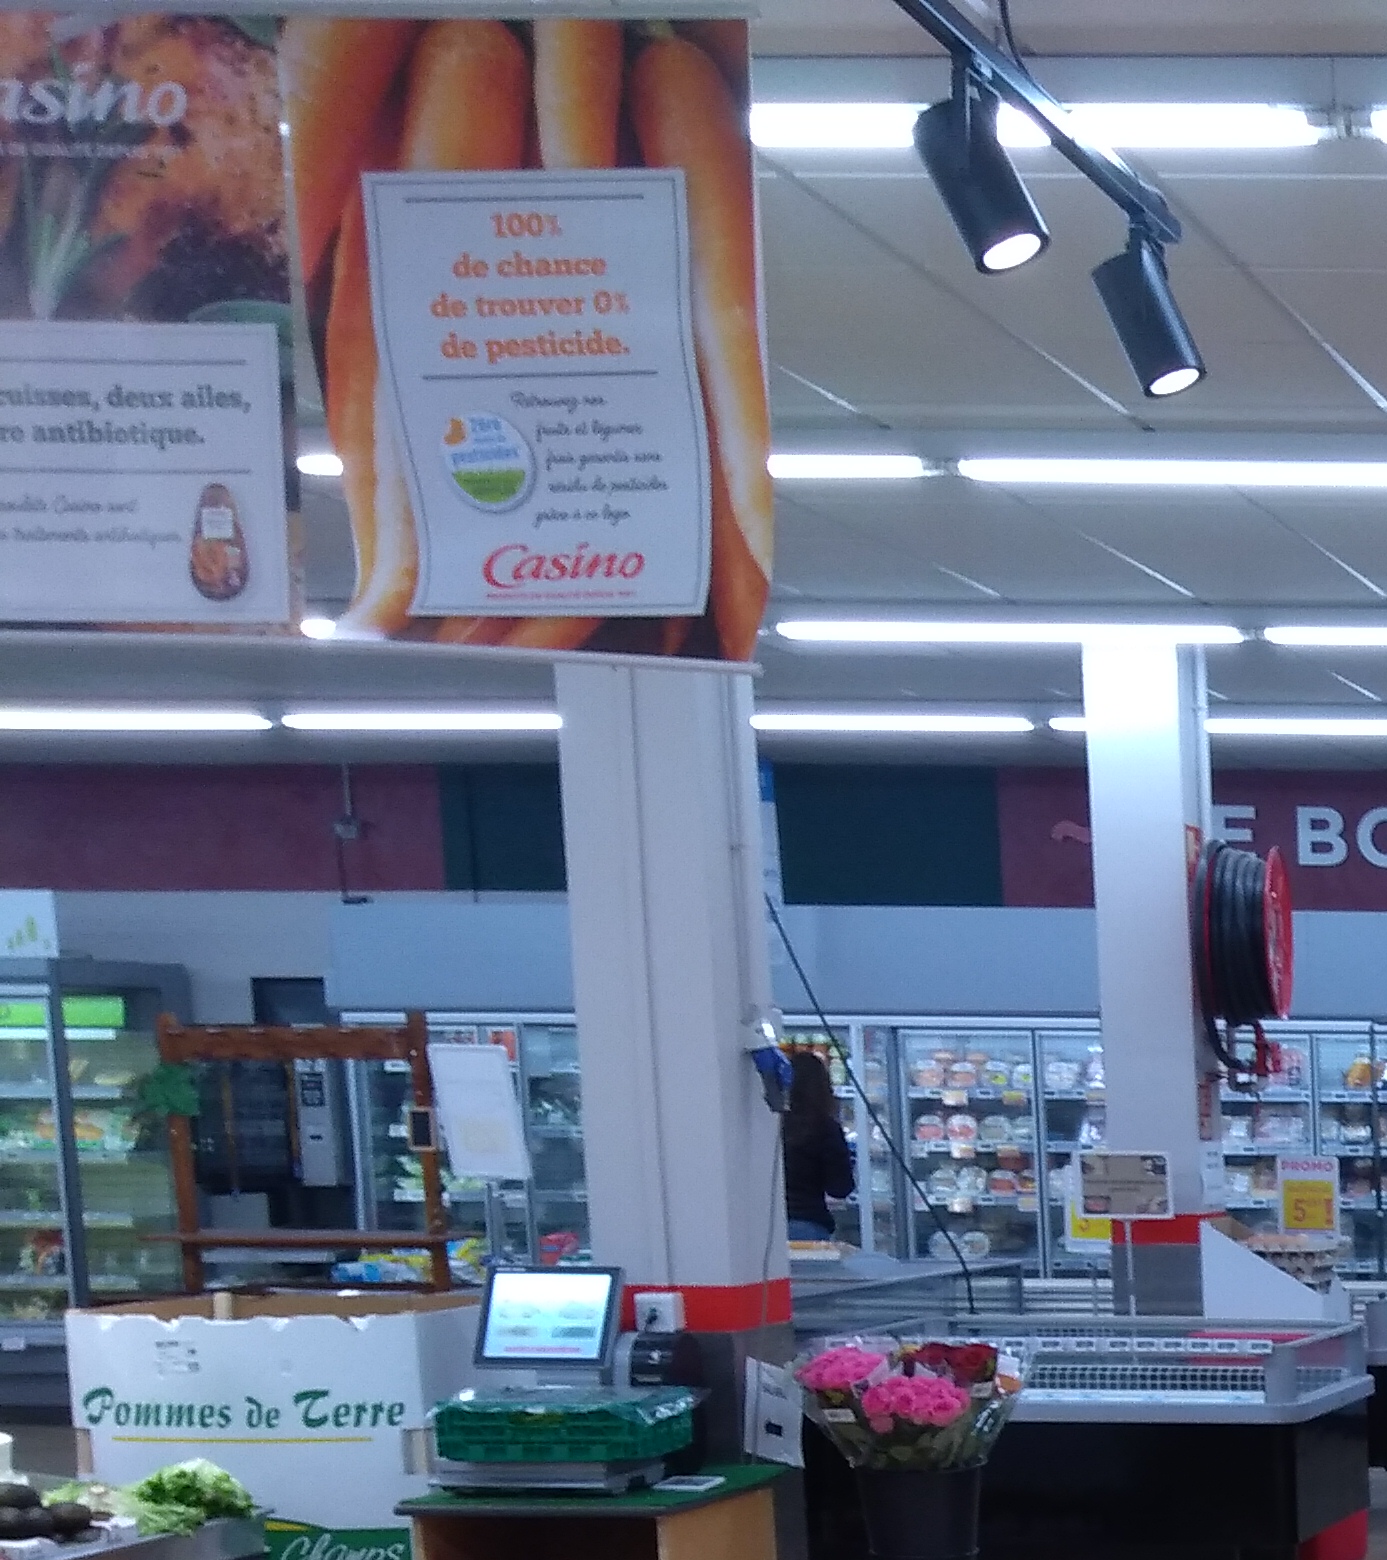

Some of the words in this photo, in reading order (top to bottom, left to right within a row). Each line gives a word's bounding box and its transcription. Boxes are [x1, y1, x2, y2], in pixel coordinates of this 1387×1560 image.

[491, 212, 562, 238] 100%
[453, 252, 489, 278] de
[497, 251, 606, 278] chance
[430, 292, 468, 318] de
[475, 296, 586, 317] trouver
[593, 290, 630, 315] 0%
[441, 332, 478, 359] de
[485, 329, 630, 365] pesticide.
[107, 384, 173, 408] deux
[180, 384, 250, 413] ailes,
[32, 420, 205, 450] antibiotique.
[482, 541, 646, 589] Casino
[1281, 1160, 1334, 1172] PROMO
[83, 1387, 233, 1429] Pommes
[245, 1396, 281, 1429] de
[293, 1389, 406, 1429] Terre
